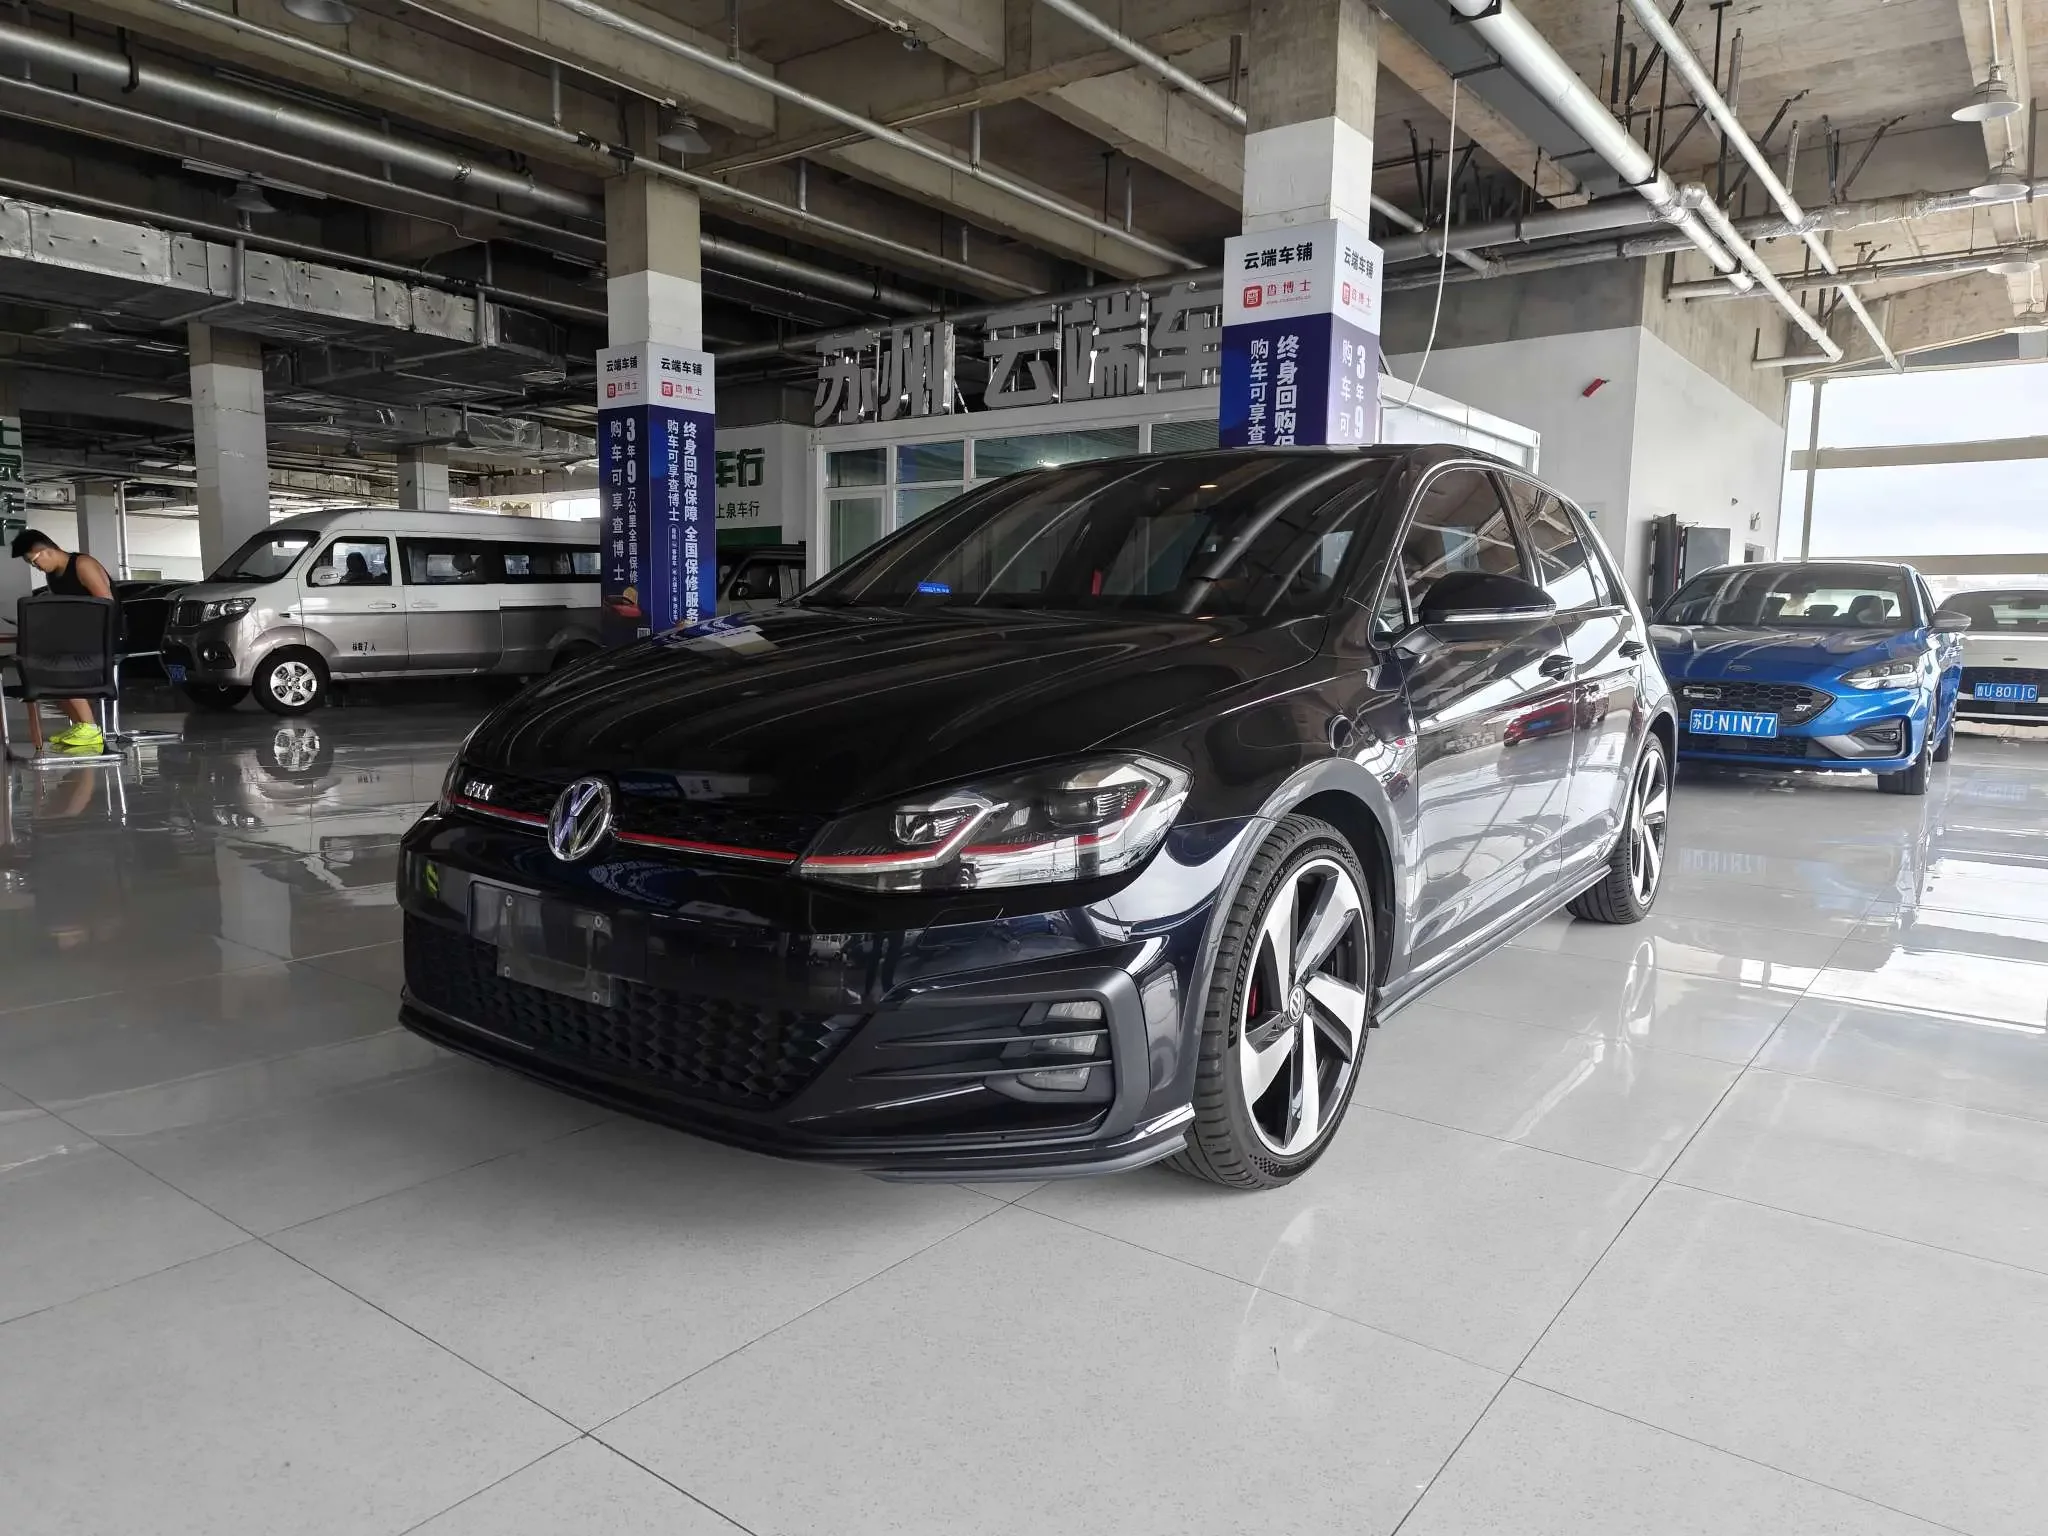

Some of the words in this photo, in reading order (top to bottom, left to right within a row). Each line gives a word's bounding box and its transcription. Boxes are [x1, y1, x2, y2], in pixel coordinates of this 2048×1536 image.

[1244, 242, 1313, 270] 云端车铺
[1344, 246, 1374, 279] 云端车铺
[606, 356, 638, 372] 云端车铺
[661, 358, 702, 376] 云端车铺
[1248, 339, 1269, 444] 购车可享查
[1340, 340, 1353, 437] 购车可
[610, 420, 624, 581] 购车可享查博士
[667, 420, 680, 521] 购车可享查博士
[716, 501, 760, 519] 上泉车行
[1231, 925, 1257, 1016] MICHELIN
